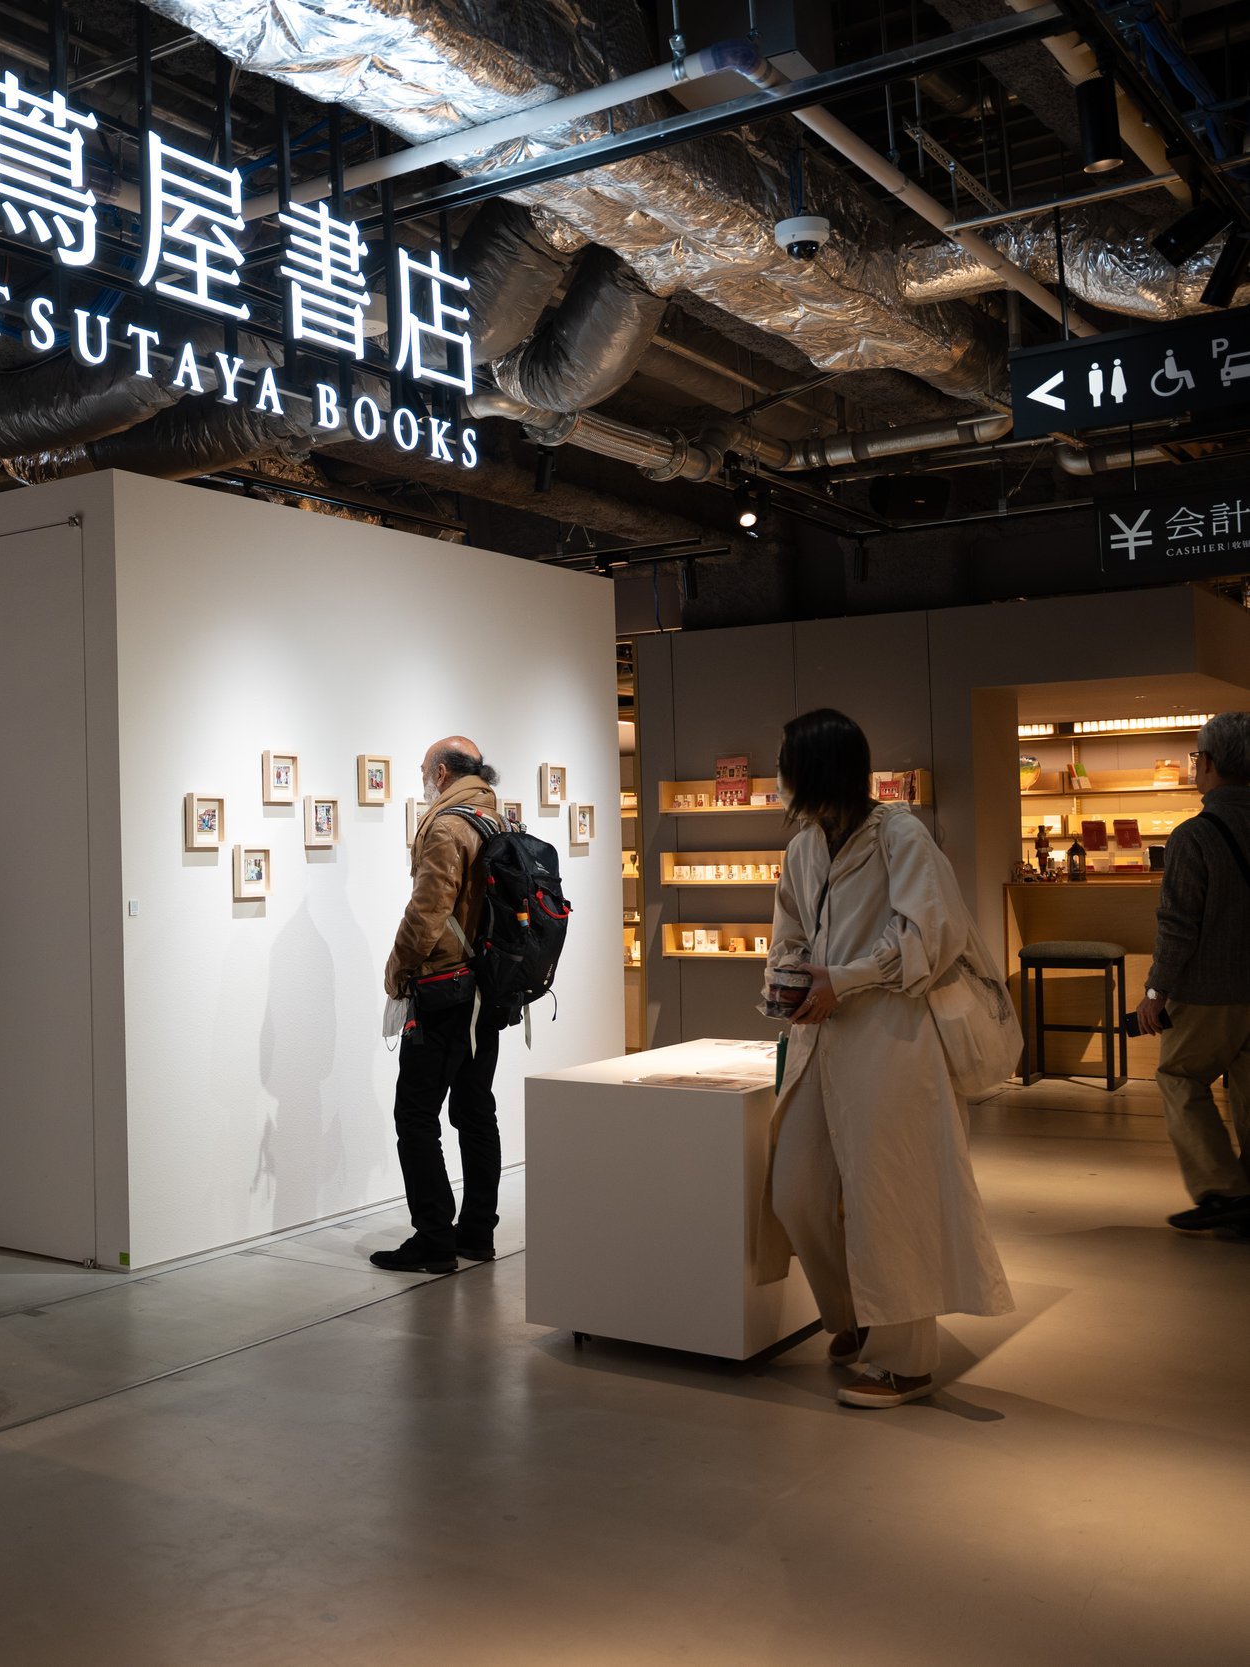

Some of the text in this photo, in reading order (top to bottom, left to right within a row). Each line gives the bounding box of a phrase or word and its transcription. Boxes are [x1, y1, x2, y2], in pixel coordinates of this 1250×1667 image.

[1211, 338, 1229, 359] P
[316, 383, 478, 469] BOOKS
[1165, 500, 1250, 540] 会計
[1166, 543, 1225, 557] CASHIER
